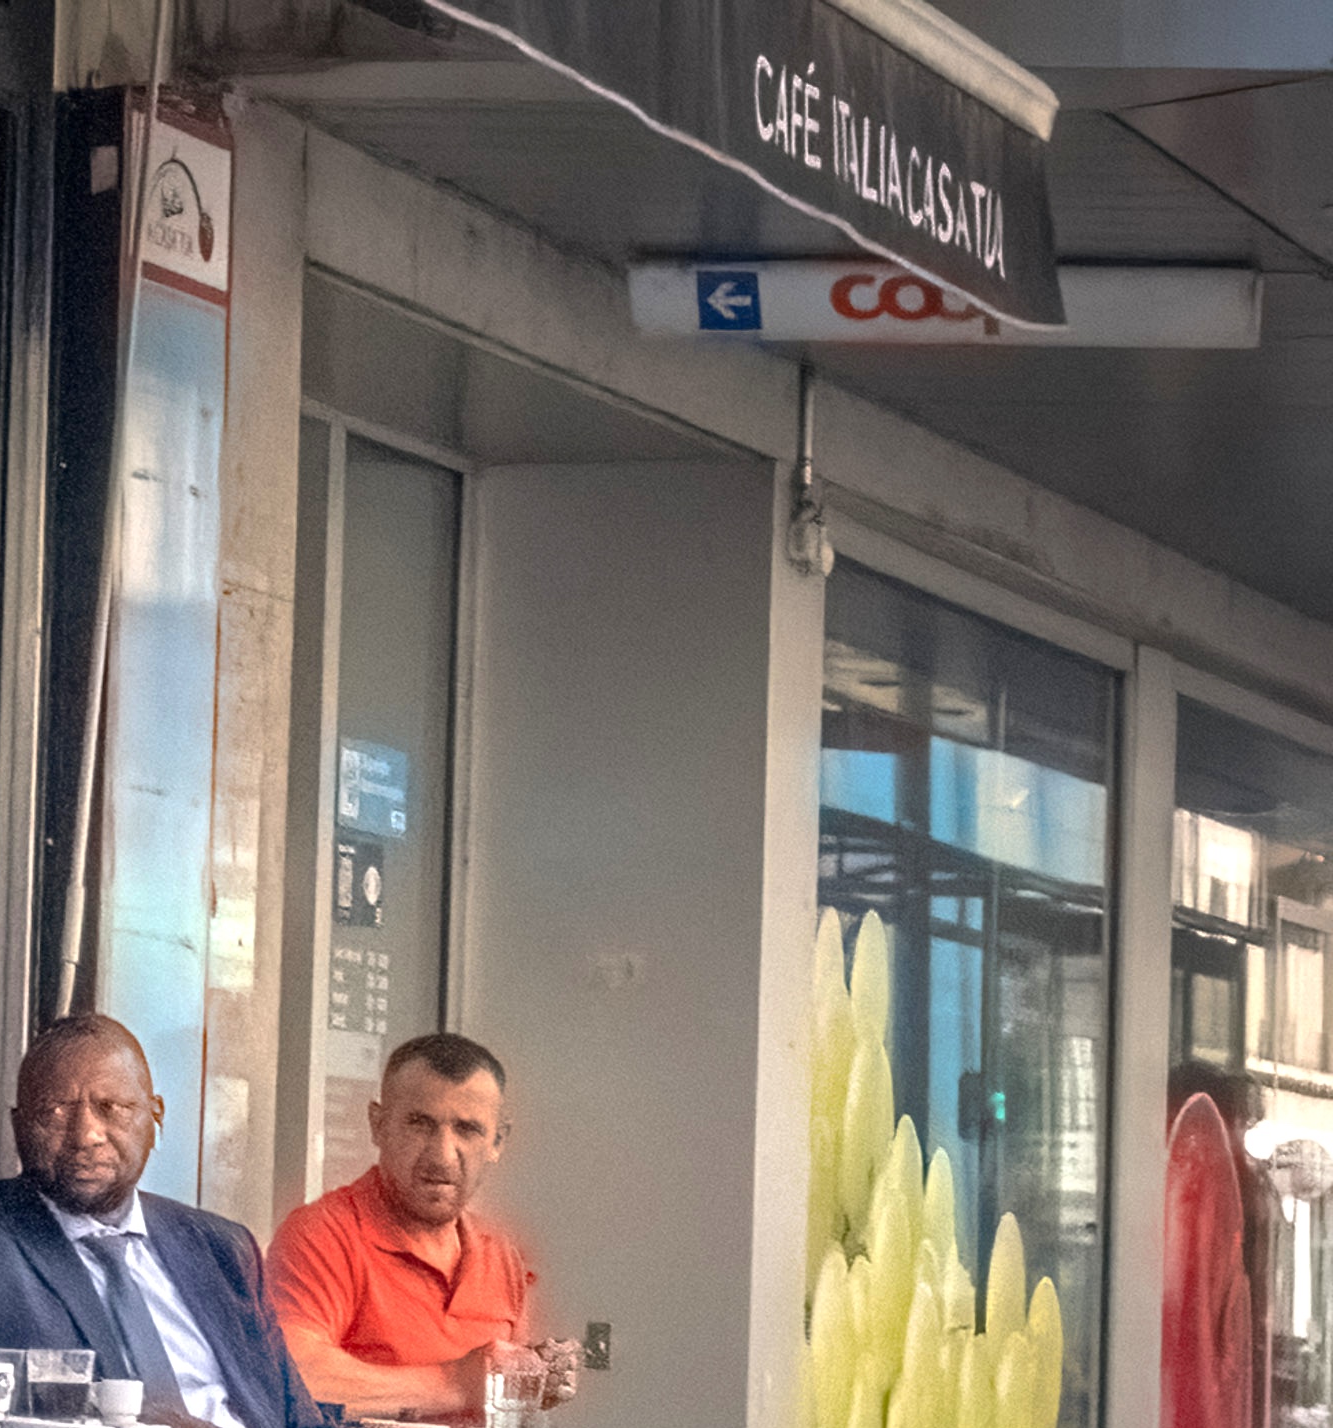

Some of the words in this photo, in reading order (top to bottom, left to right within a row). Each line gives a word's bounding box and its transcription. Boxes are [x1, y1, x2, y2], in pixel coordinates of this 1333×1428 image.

[754, 54, 822, 170] CAFÉ
[832, 94, 905, 217] ITALIA
[829, 273, 1001, 336] co
